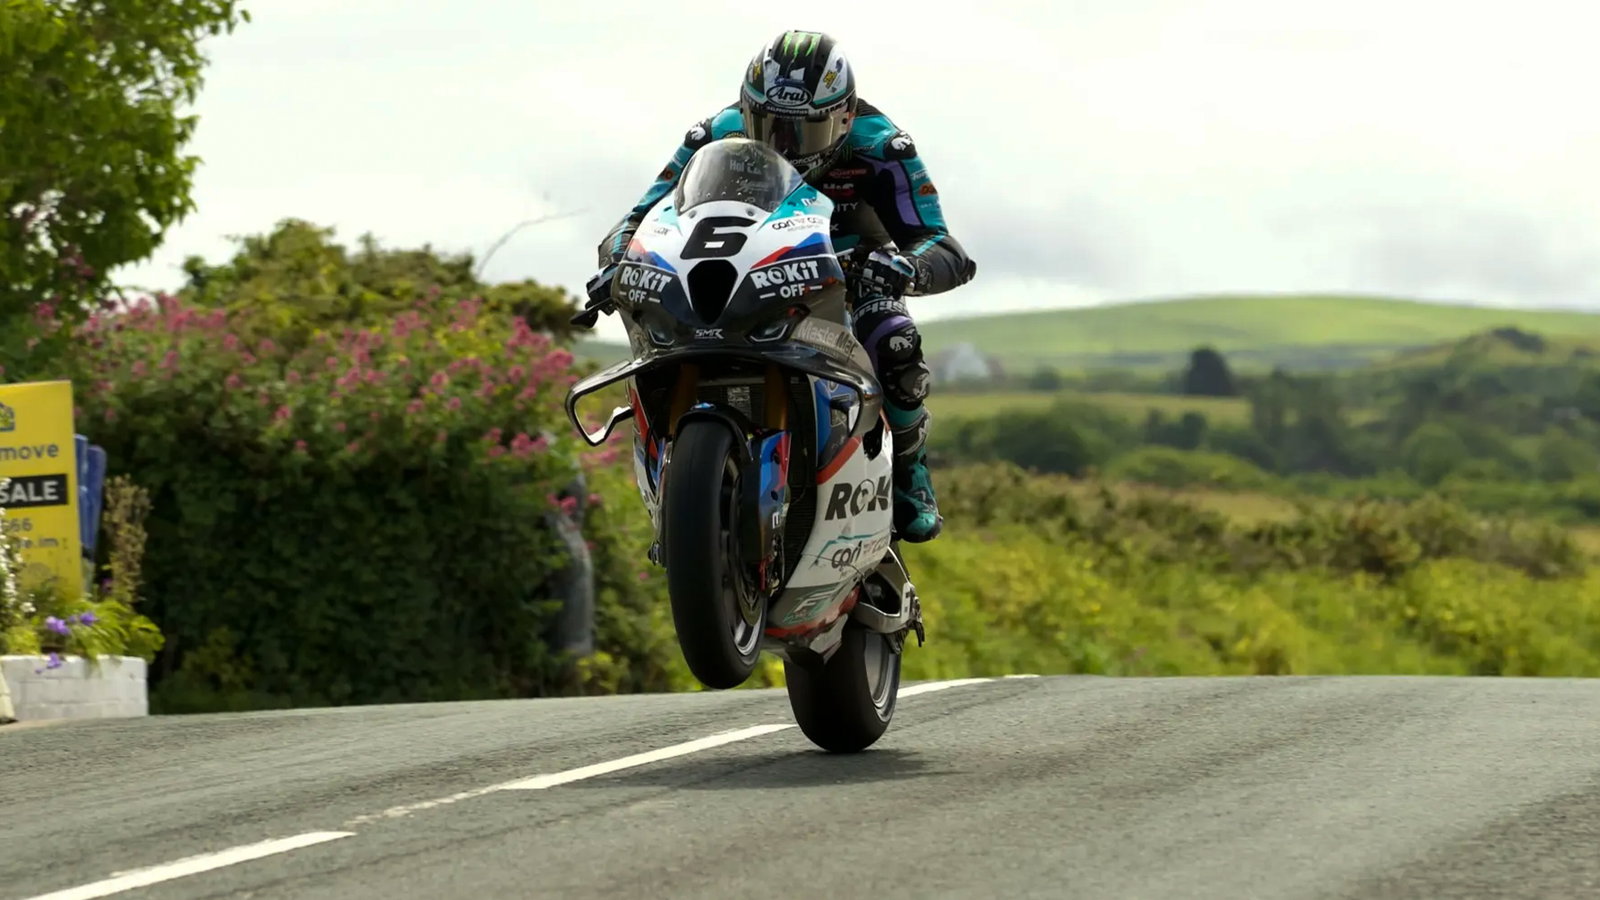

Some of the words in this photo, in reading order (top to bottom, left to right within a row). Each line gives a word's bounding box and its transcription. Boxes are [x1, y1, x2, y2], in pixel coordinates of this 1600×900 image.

[768, 86, 805, 101] Arai
[680, 216, 757, 260] 6
[628, 290, 647, 303] OFF
[780, 283, 806, 299] OFF
[0, 481, 59, 503] SALE
